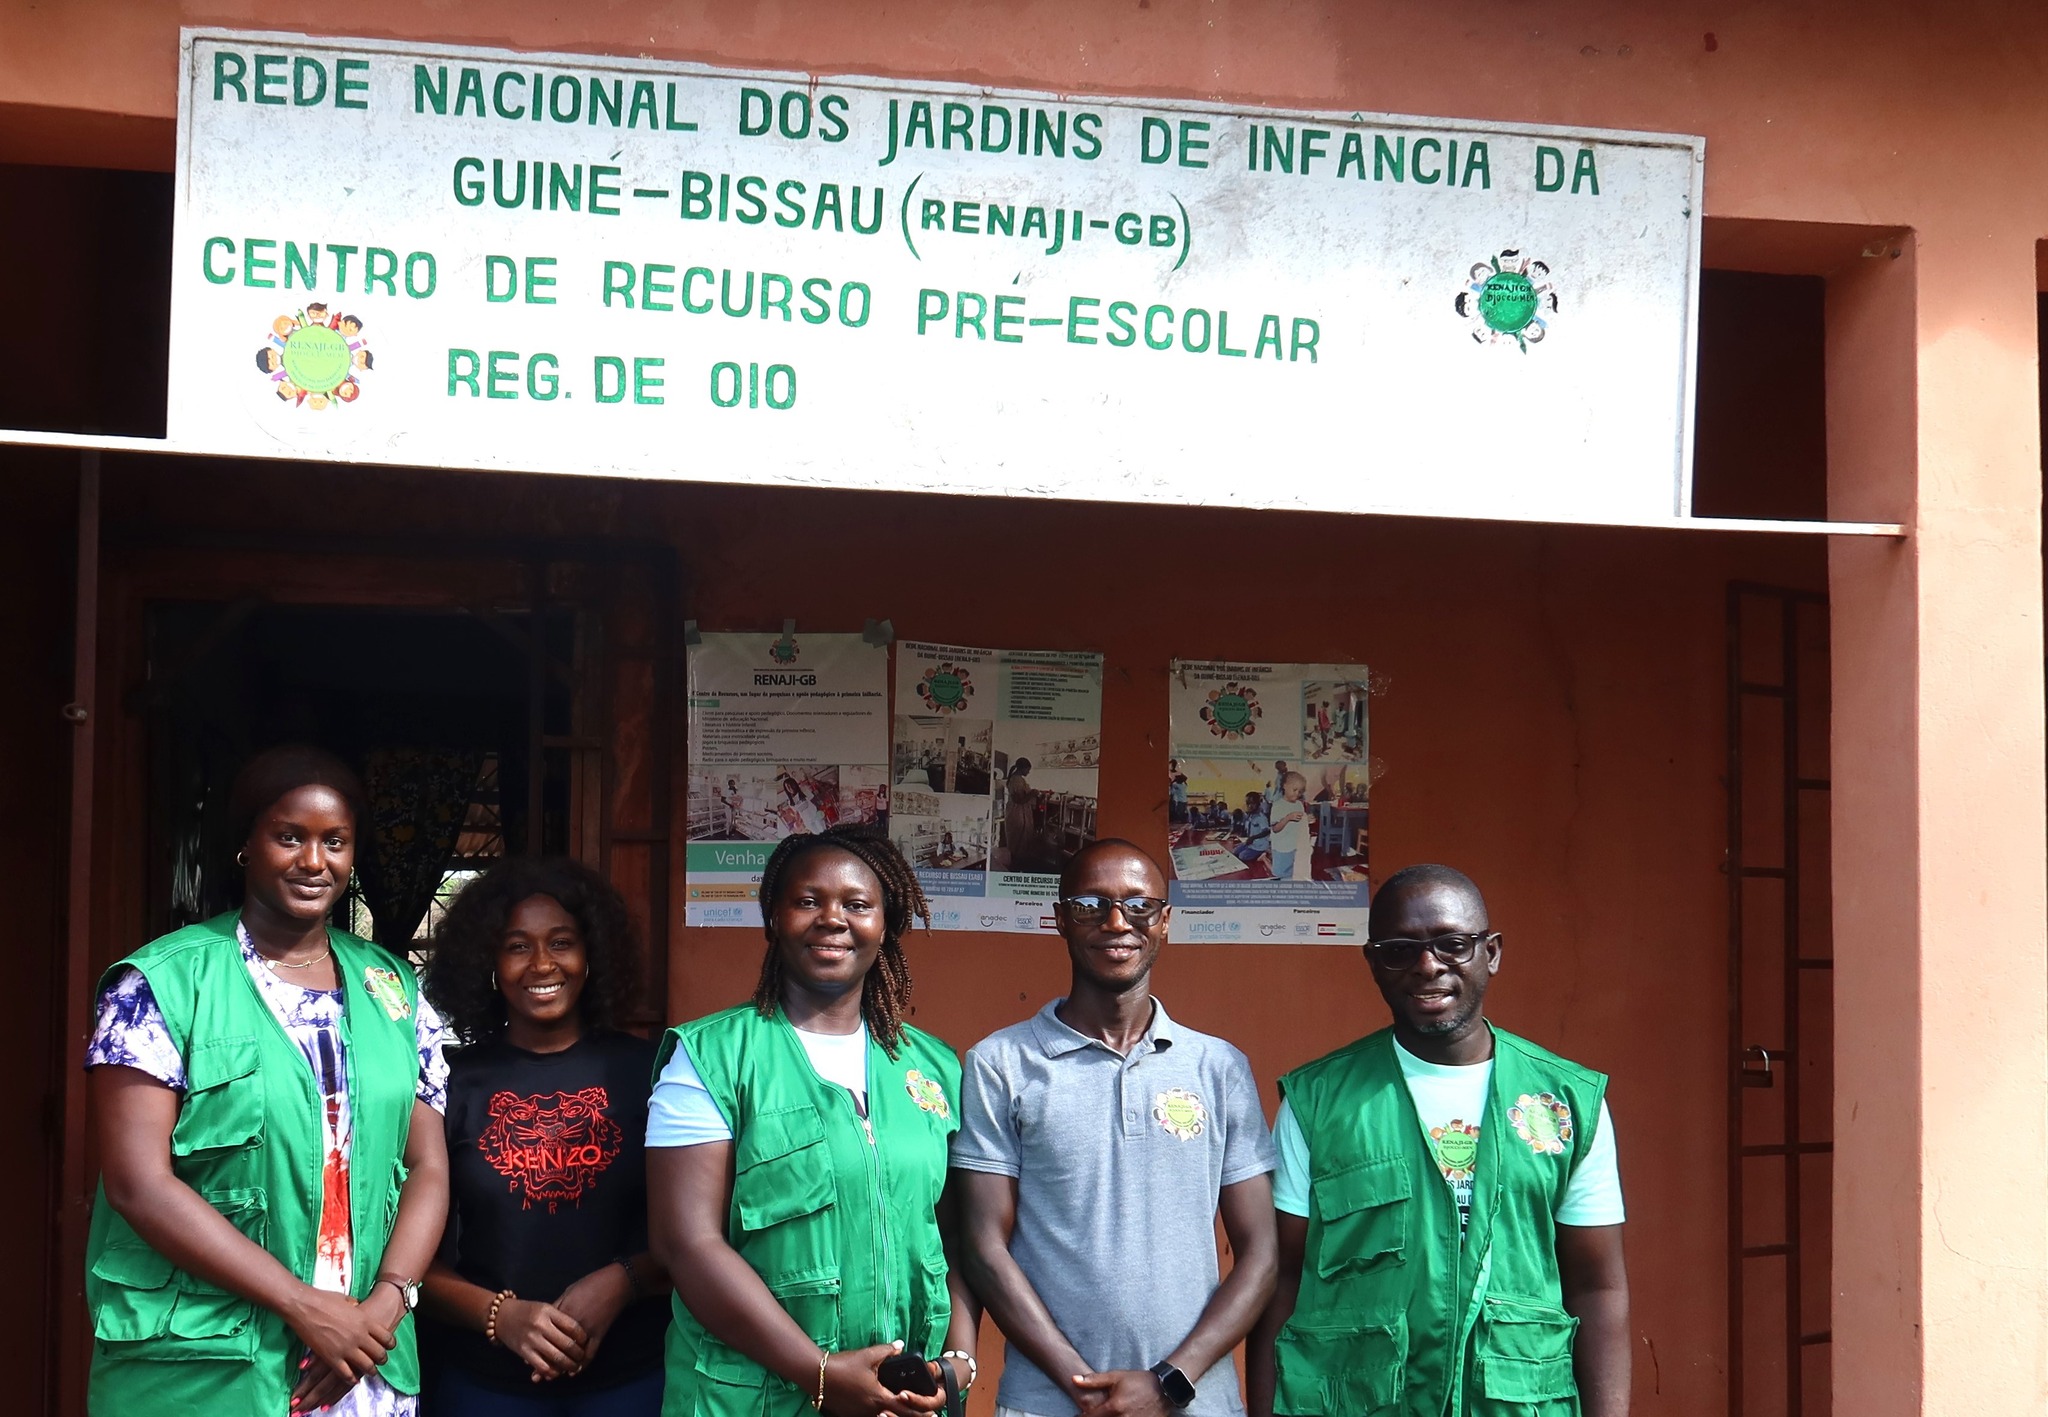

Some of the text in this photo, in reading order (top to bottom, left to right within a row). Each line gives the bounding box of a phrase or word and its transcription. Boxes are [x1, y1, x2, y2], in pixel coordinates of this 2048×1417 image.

[214, 54, 1599, 196] REDE NACIONAL DOS JARDINS DE INFÂNCIA DA
[203, 236, 1320, 364] CENTRO DE RECURSO PRÉ-ESCOLAR
[447, 348, 796, 410] REG. DE OIO
[754, 674, 817, 686] RENAJI-GB
[715, 850, 766, 865] Venha
[1003, 875, 1022, 883] CENTRO
[704, 907, 732, 917] unicef
[1189, 921, 1226, 932] unicef
[507, 1145, 601, 1170] KENZO
